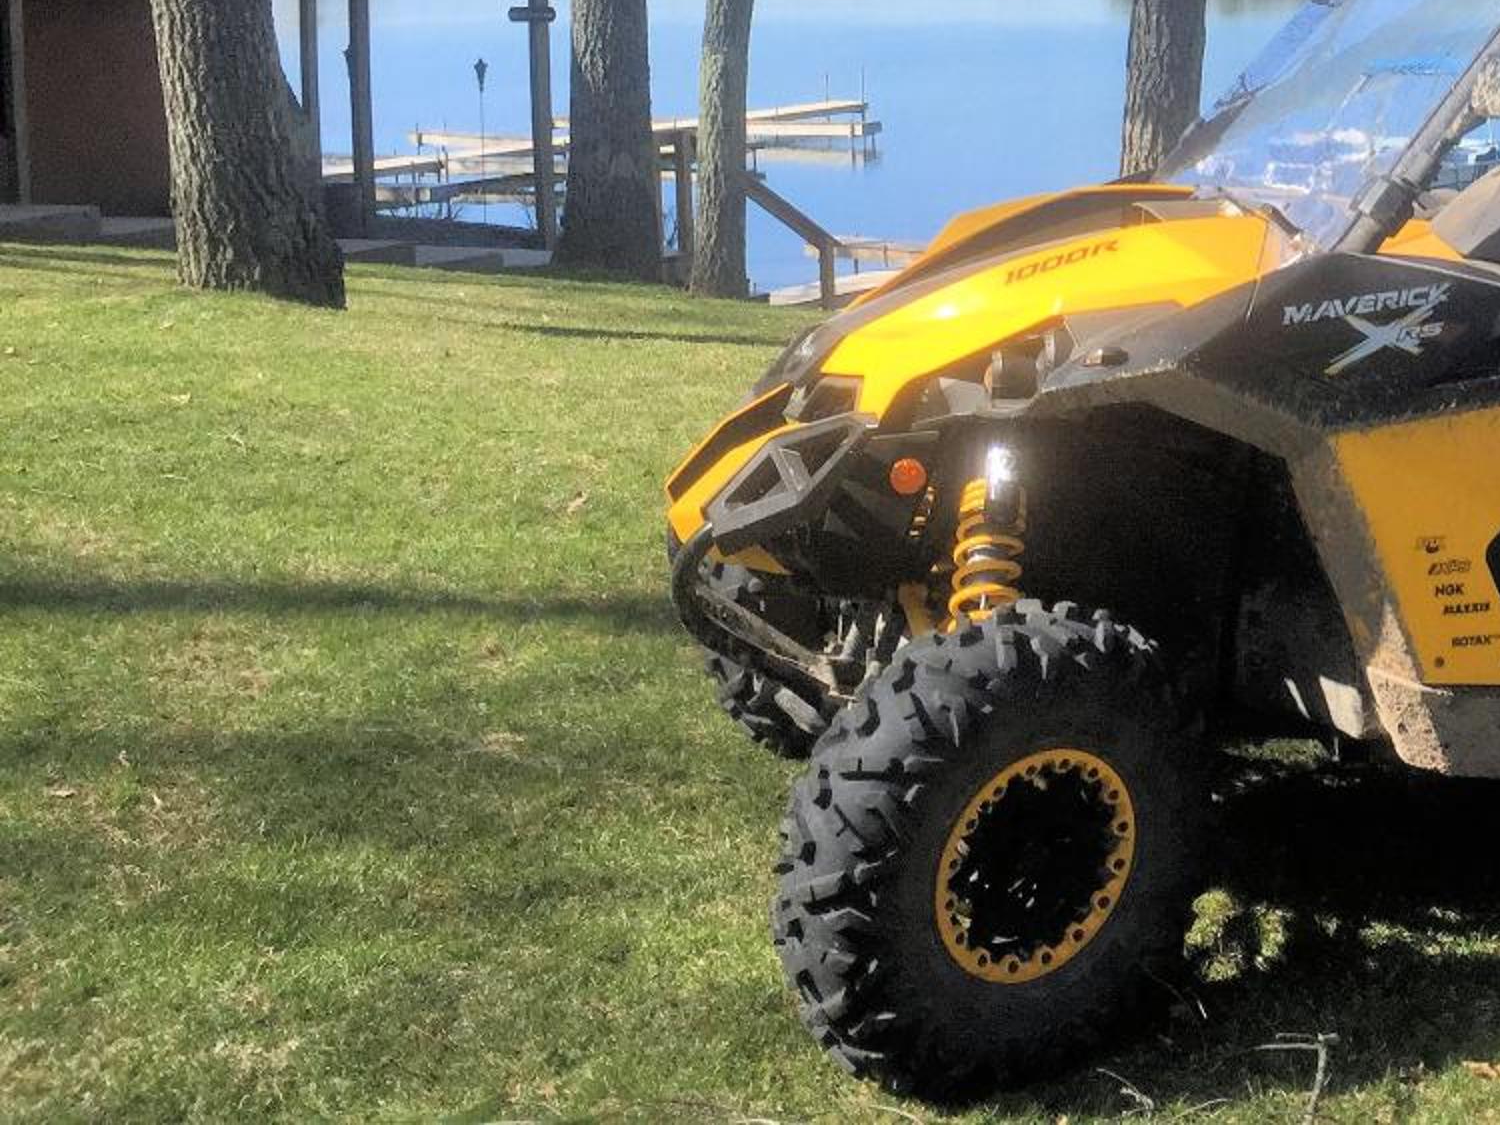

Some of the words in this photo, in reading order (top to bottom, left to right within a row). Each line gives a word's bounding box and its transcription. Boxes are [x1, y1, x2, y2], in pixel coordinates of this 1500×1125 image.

[1005, 239, 1119, 286] 1000R
[1281, 282, 1450, 326] MAVERICK
[1434, 582, 1465, 598] NGK
